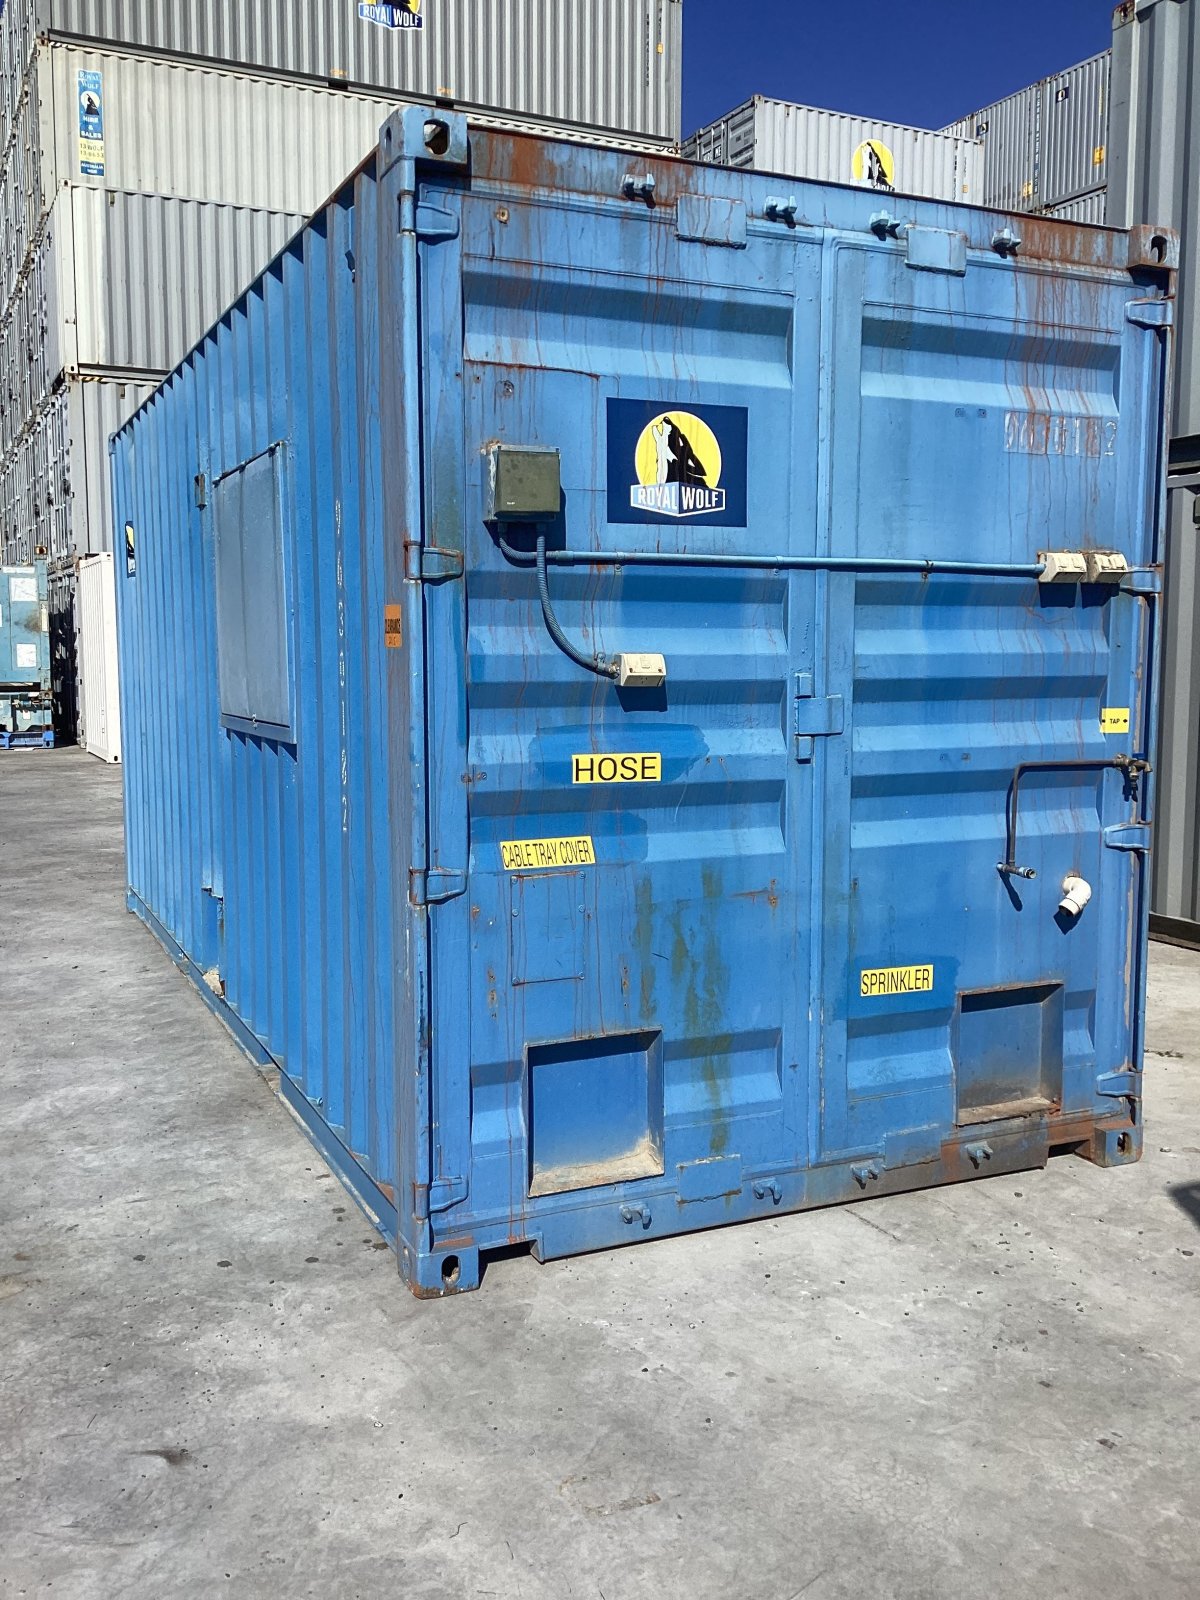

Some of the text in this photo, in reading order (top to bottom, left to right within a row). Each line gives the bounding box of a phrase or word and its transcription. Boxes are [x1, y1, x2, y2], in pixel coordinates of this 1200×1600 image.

[363, 5, 419, 26] ROYAL WOLF
[80, 130, 102, 139] SALES
[637, 485, 719, 510] ROYAL WOLF
[575, 756, 657, 782] HOSE
[502, 840, 592, 868] CABLE TRAY COVER
[861, 968, 930, 995] SPRINKLER
